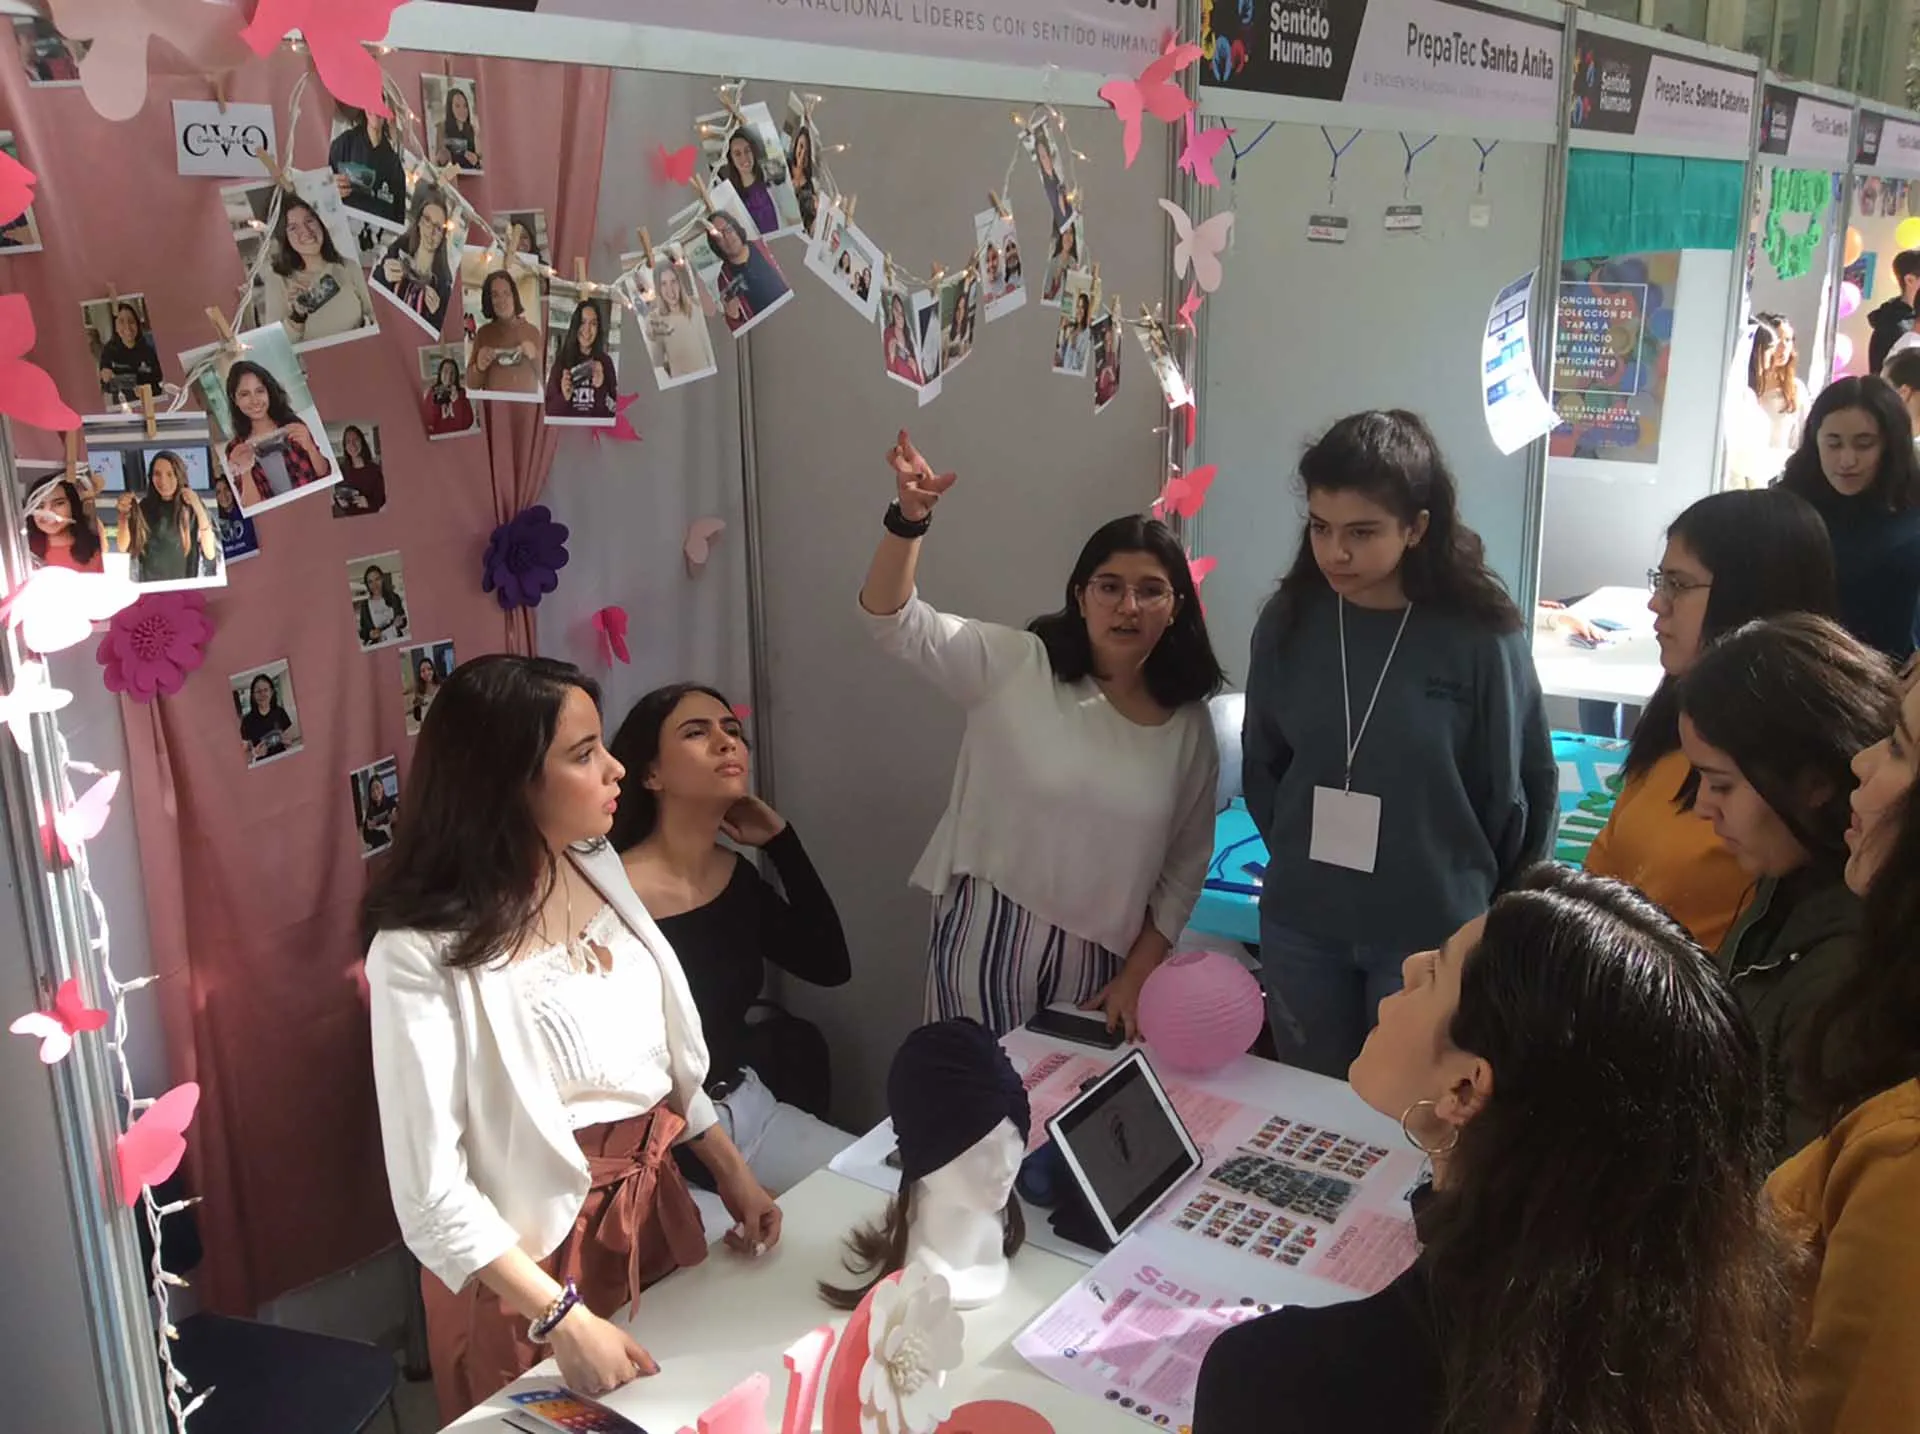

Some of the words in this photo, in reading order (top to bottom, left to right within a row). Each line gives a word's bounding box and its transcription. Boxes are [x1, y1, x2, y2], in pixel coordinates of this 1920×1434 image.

[912, 3, 985, 31] LÍDERES
[992, 15, 1025, 37] CON
[1032, 20, 1096, 47] SENTIDO
[1102, 30, 1160, 56] HUMANO
[1270, 1, 1329, 40] Sentido
[1269, 31, 1333, 69] Humano
[1407, 22, 1477, 67] PrepaTec
[1480, 37, 1518, 73] Santa
[1520, 46, 1554, 80] Anita
[1655, 75, 1694, 107] PrepaTec
[1695, 83, 1719, 109] Santa
[1720, 88, 1749, 114] Catarina
[1560, 296, 1611, 306] ONCURSO
[1560, 332, 1613, 343] BENEFICIO
[1566, 321, 1599, 330] TAPAS
[1601, 321, 1609, 330] A
[1571, 345, 1615, 356] ALIANZA
[1134, 1264, 1201, 1307] San
